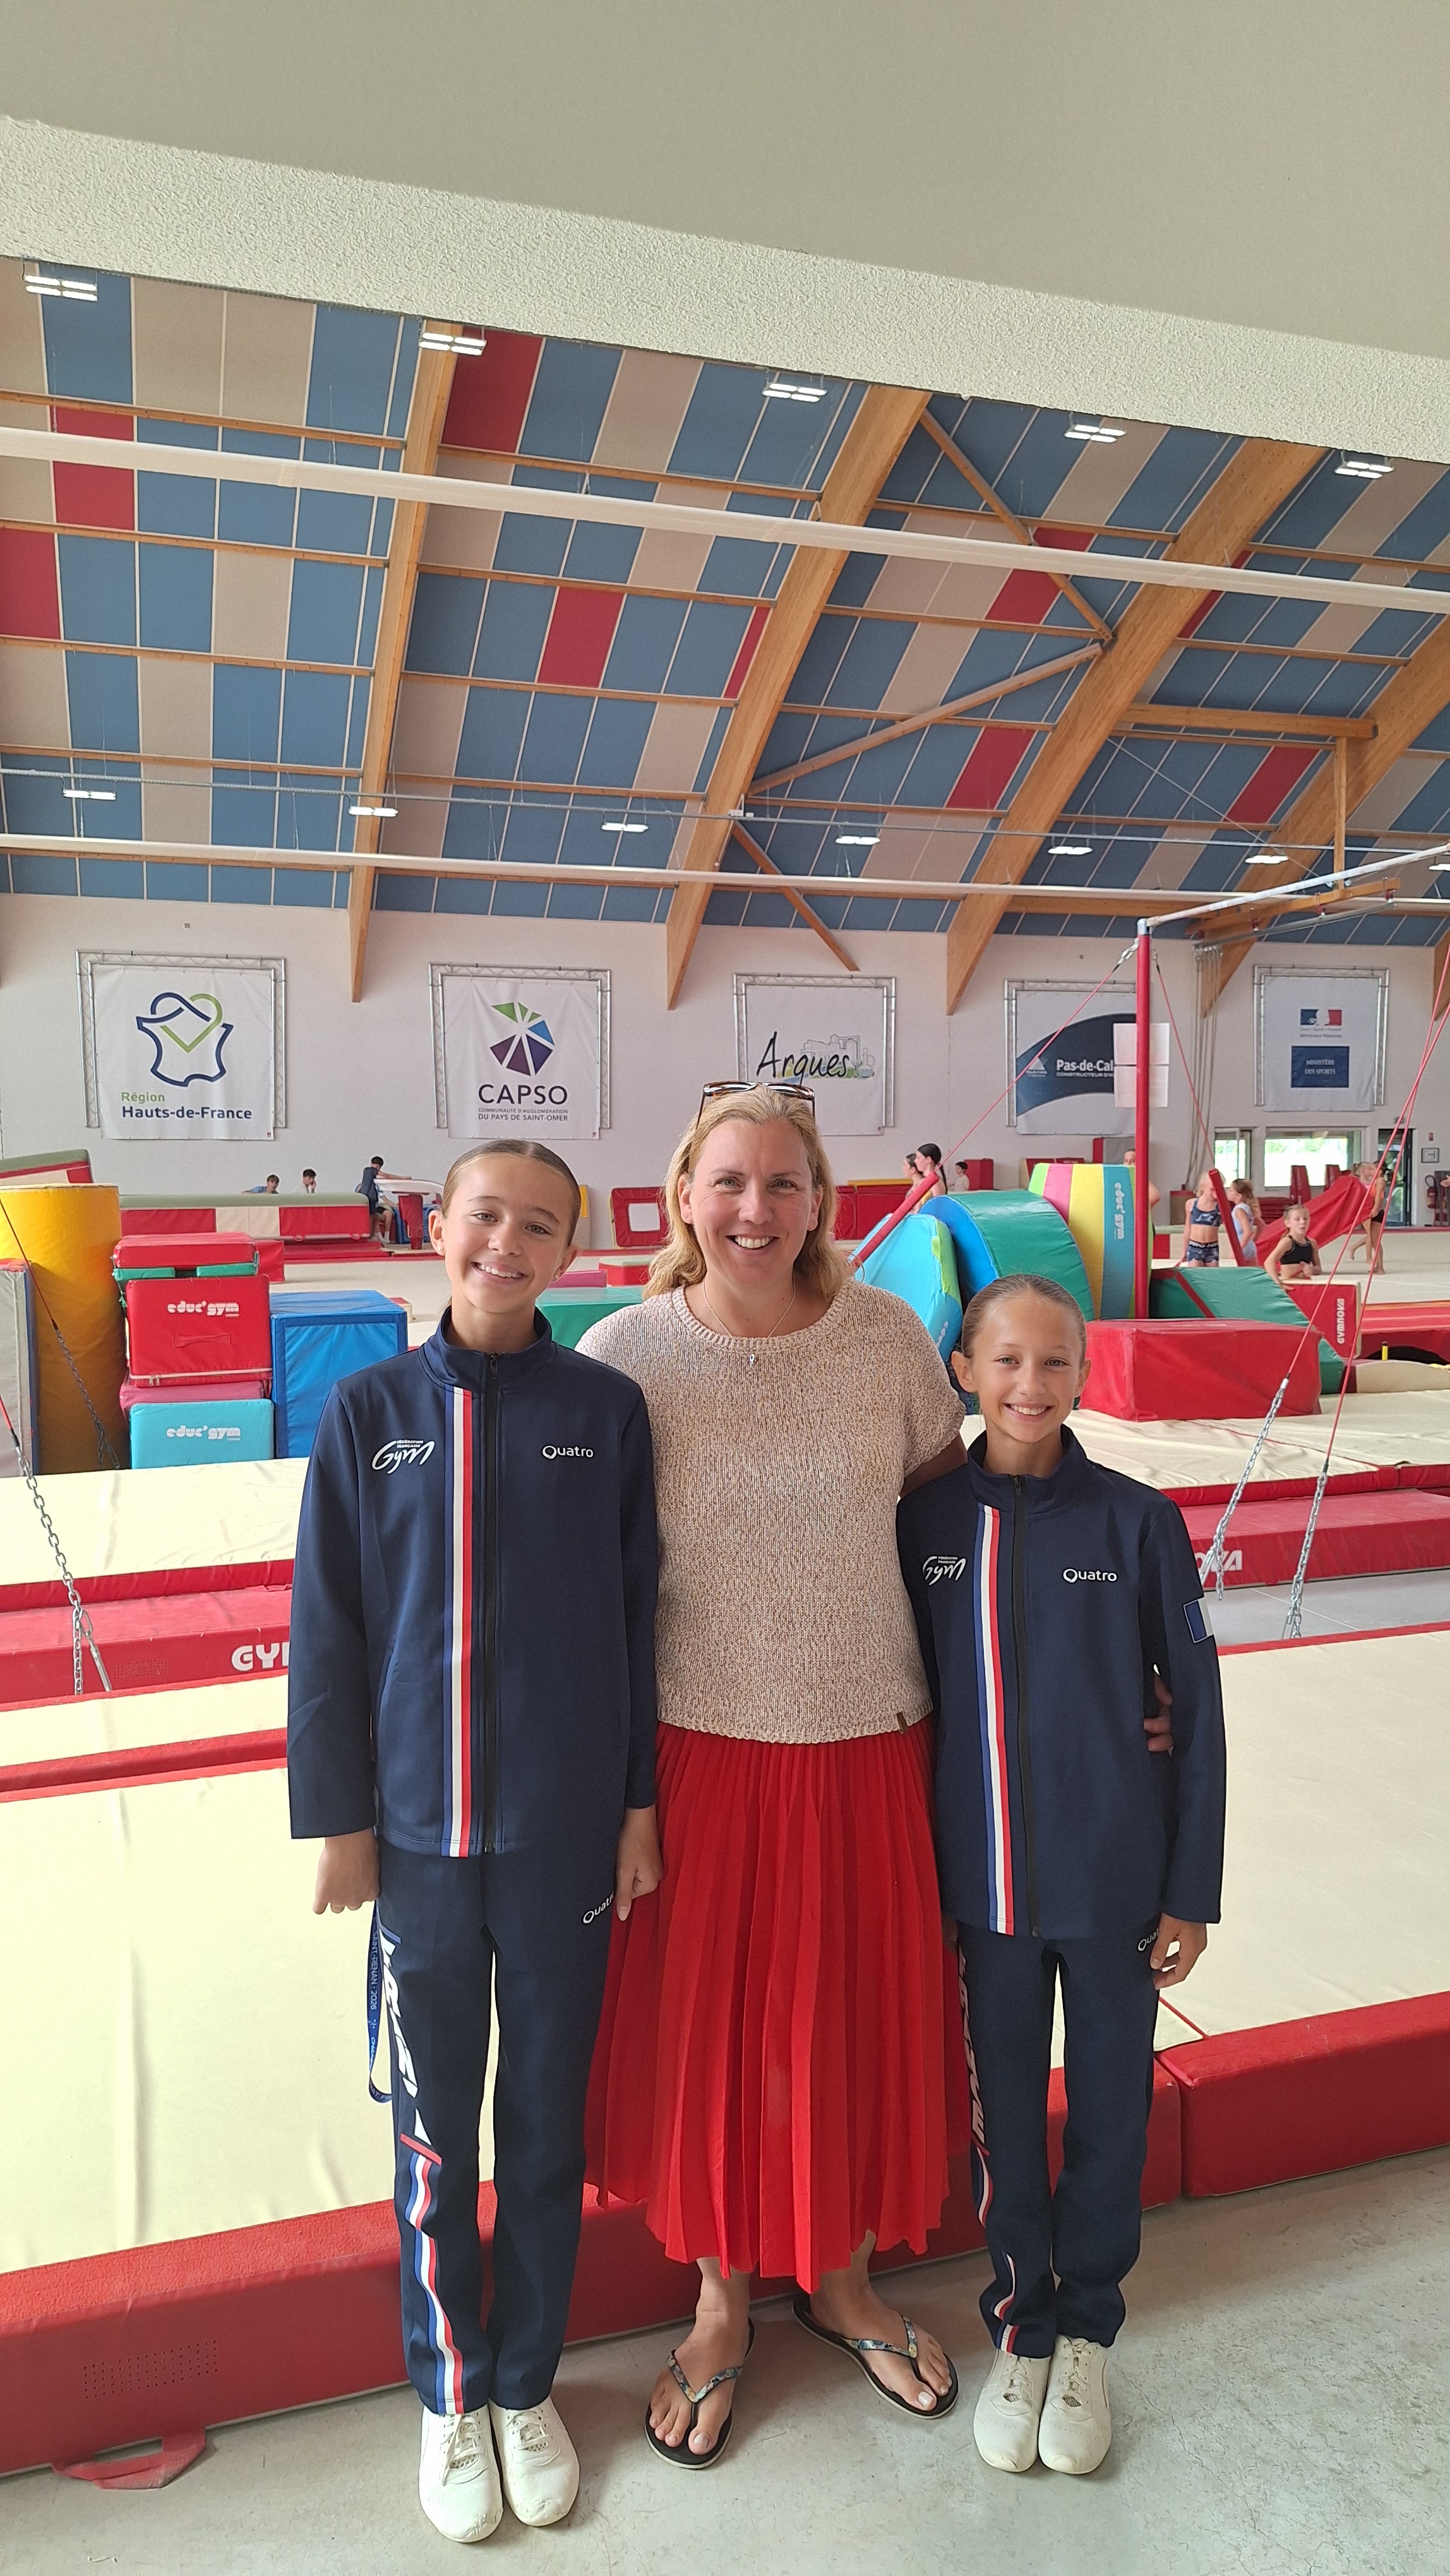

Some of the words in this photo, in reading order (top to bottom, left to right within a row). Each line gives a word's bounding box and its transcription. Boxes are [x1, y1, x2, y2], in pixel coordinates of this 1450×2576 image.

[757, 1031, 849, 1086] Arques
[121, 1092, 165, 1104] Région
[478, 1084, 568, 1105] CAPSO
[122, 1106, 252, 1119] Hauts-de-France
[542, 1445, 594, 1460] Quatro
[1063, 1568, 1117, 1583] Quatro
